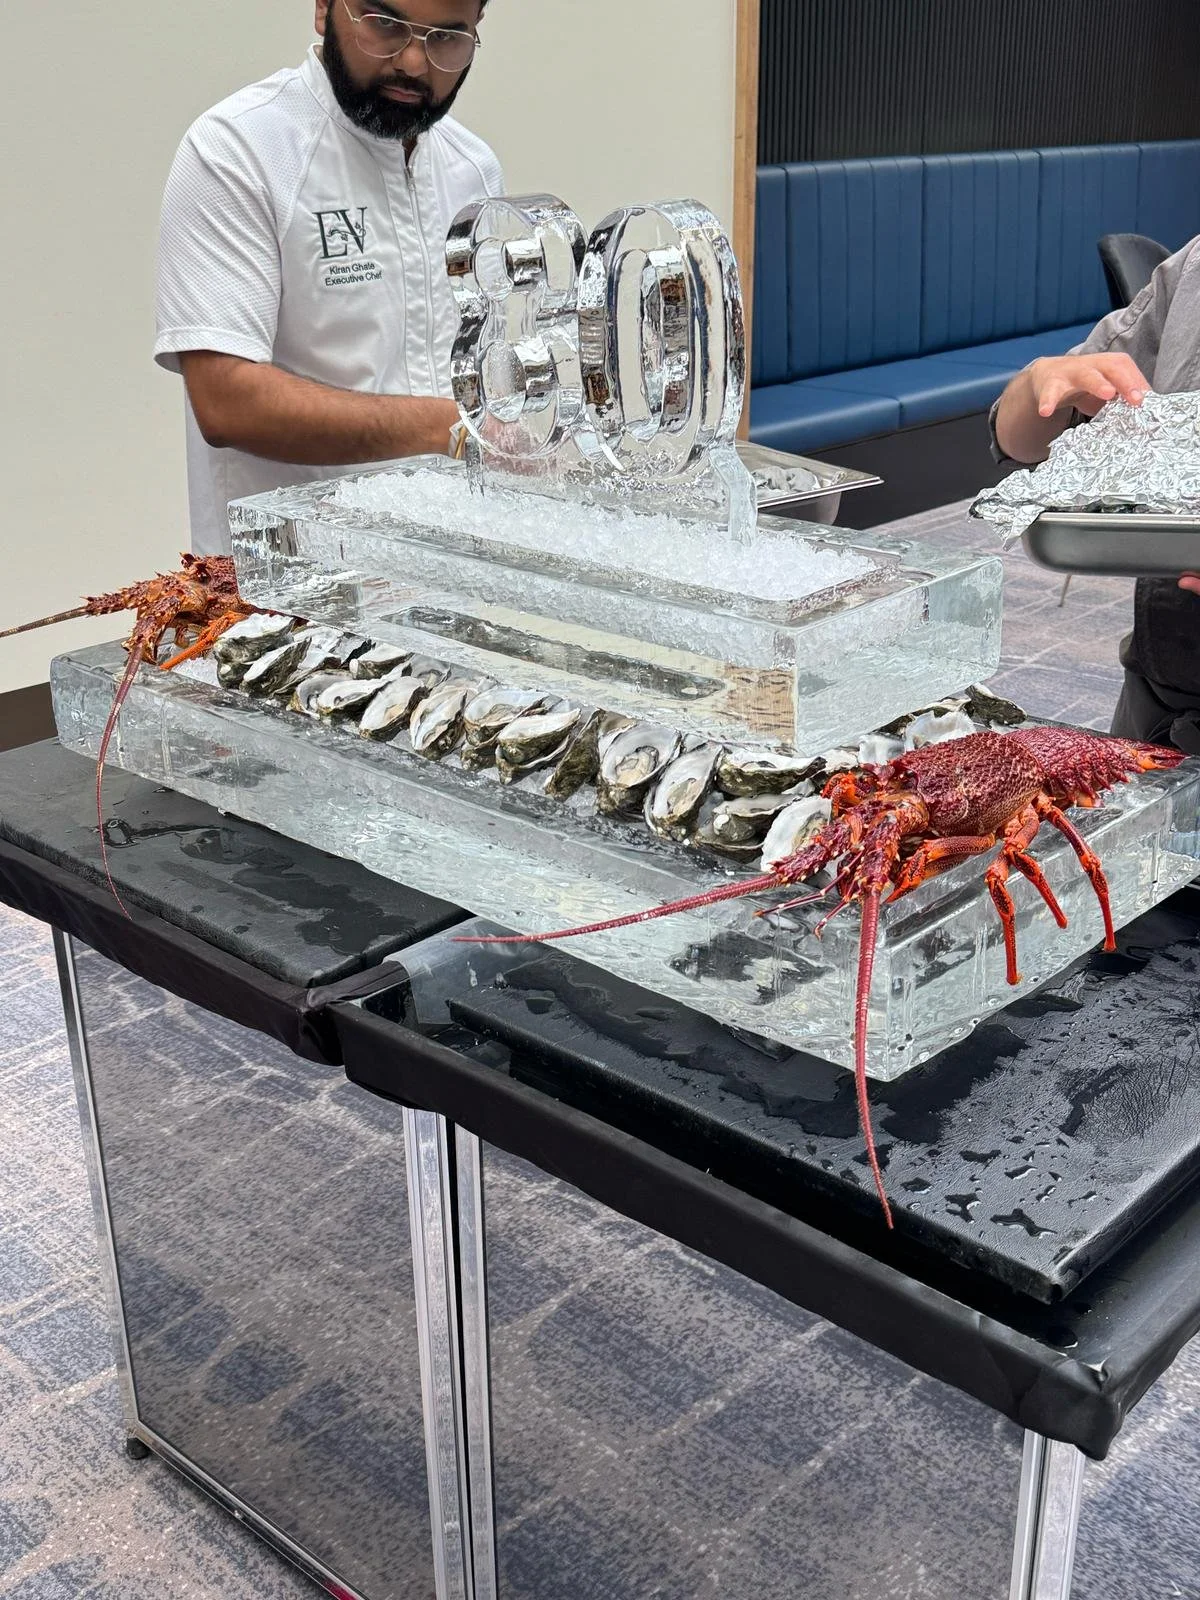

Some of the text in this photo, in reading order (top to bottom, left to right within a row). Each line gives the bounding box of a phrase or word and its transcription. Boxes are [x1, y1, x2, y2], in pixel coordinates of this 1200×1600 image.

[312, 207, 367, 259] EV
[325, 271, 382, 286] Executive Chef
[329, 265, 350, 275] Kiran
[445, 193, 745, 479] 80
